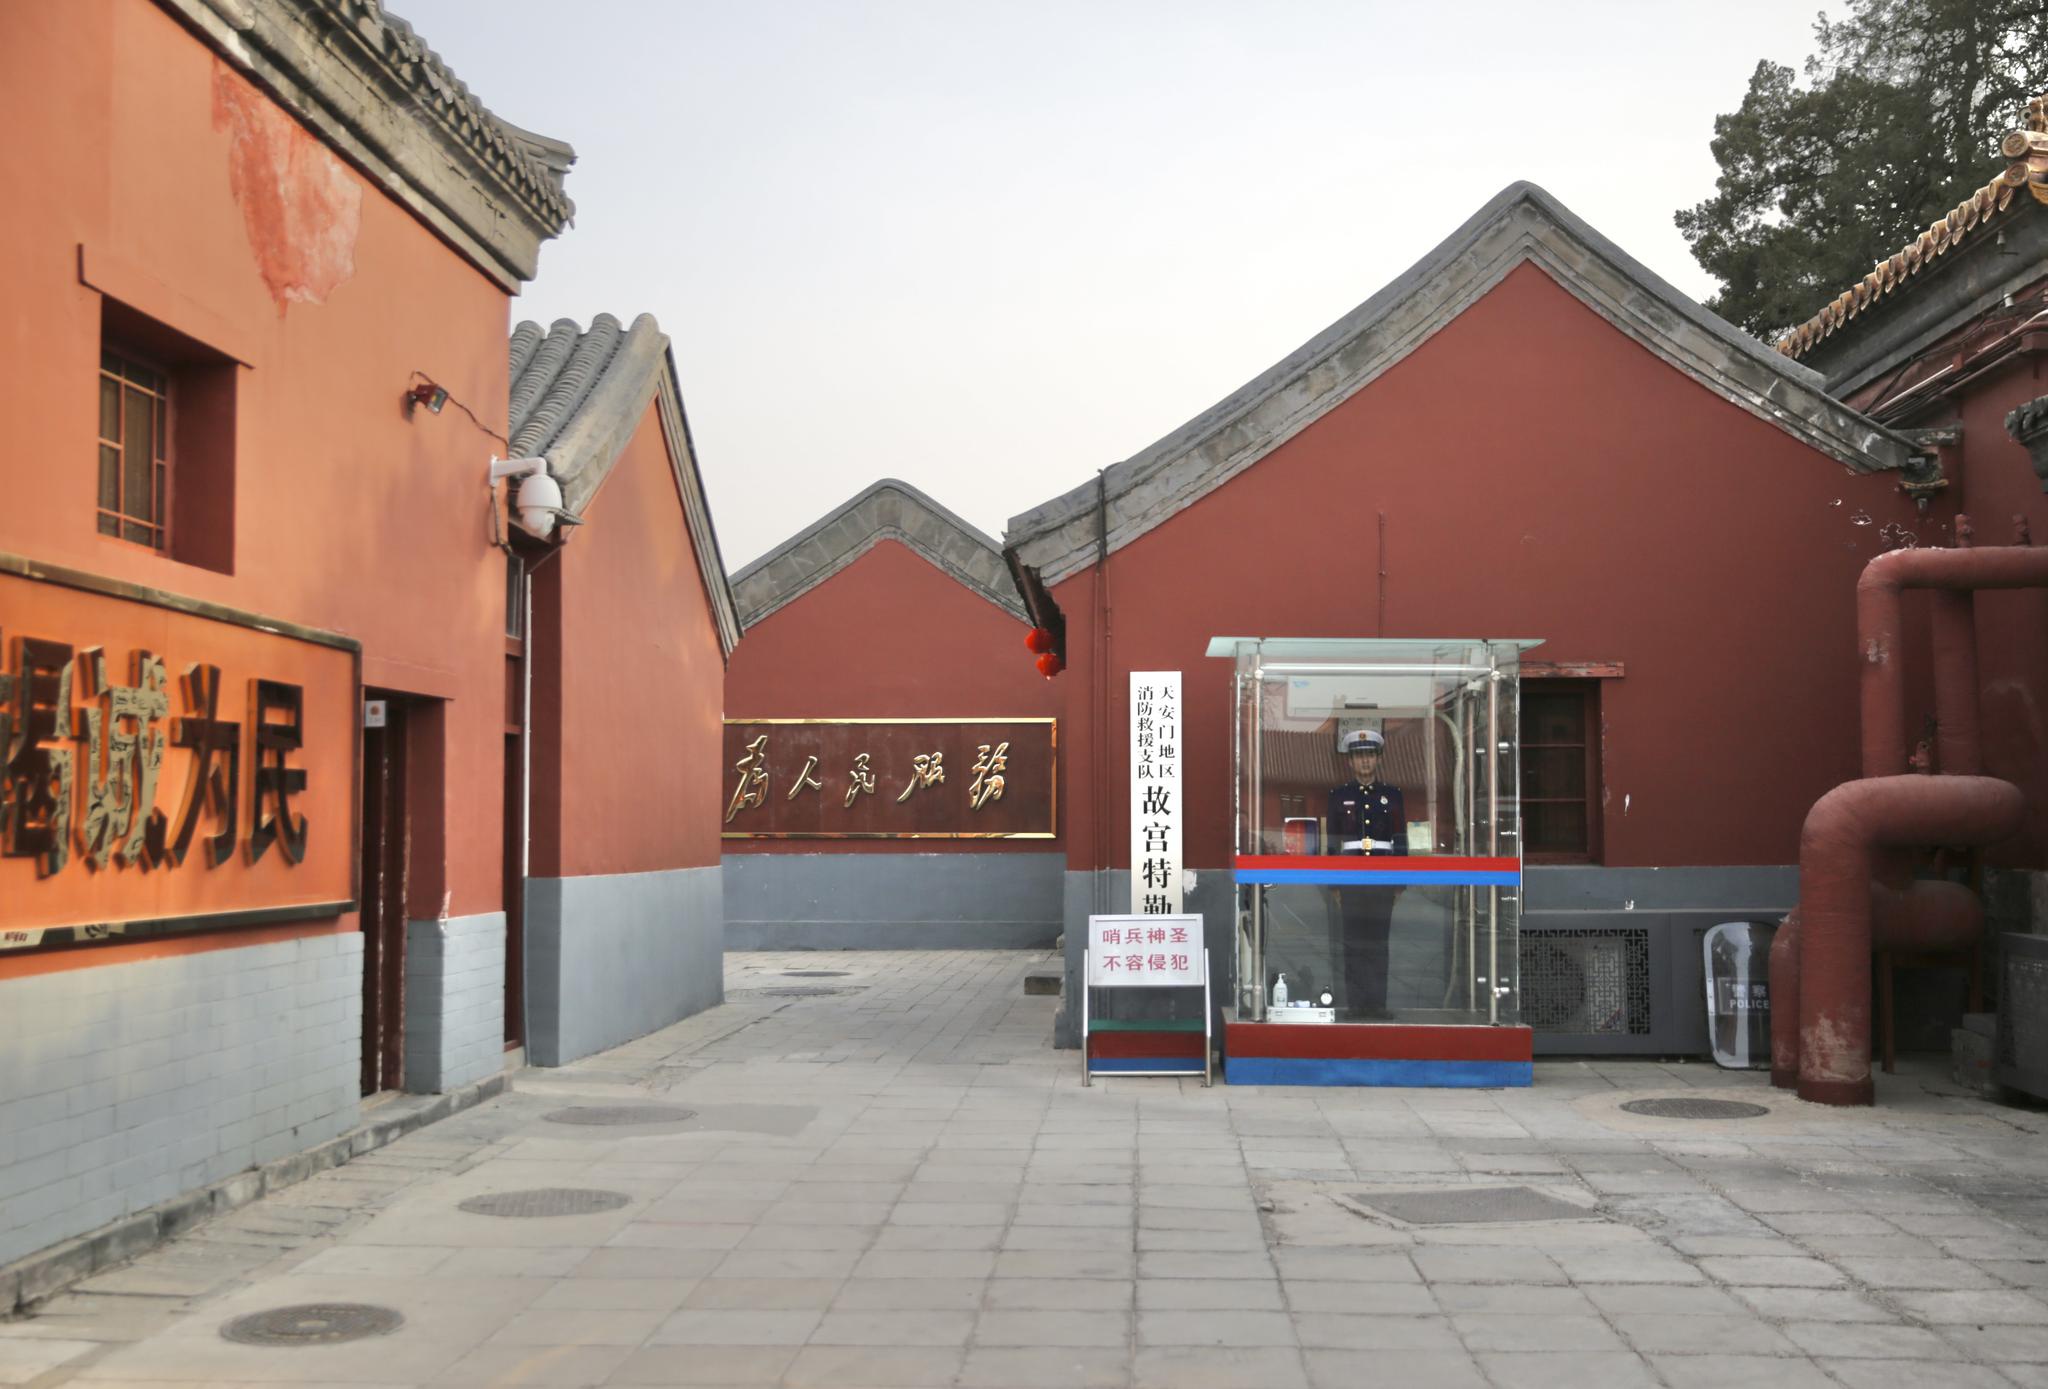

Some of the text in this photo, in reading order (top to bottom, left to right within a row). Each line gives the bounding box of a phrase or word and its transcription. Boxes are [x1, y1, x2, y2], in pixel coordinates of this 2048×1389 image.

[1137, 685, 1154, 779] 消防救援支队
[1158, 685, 1175, 778] 天安门地区
[1102, 927, 1188, 945] 哨兵神圣
[1103, 953, 1189, 972] 不容侵犯
[1729, 999, 1770, 1009] POLICE
